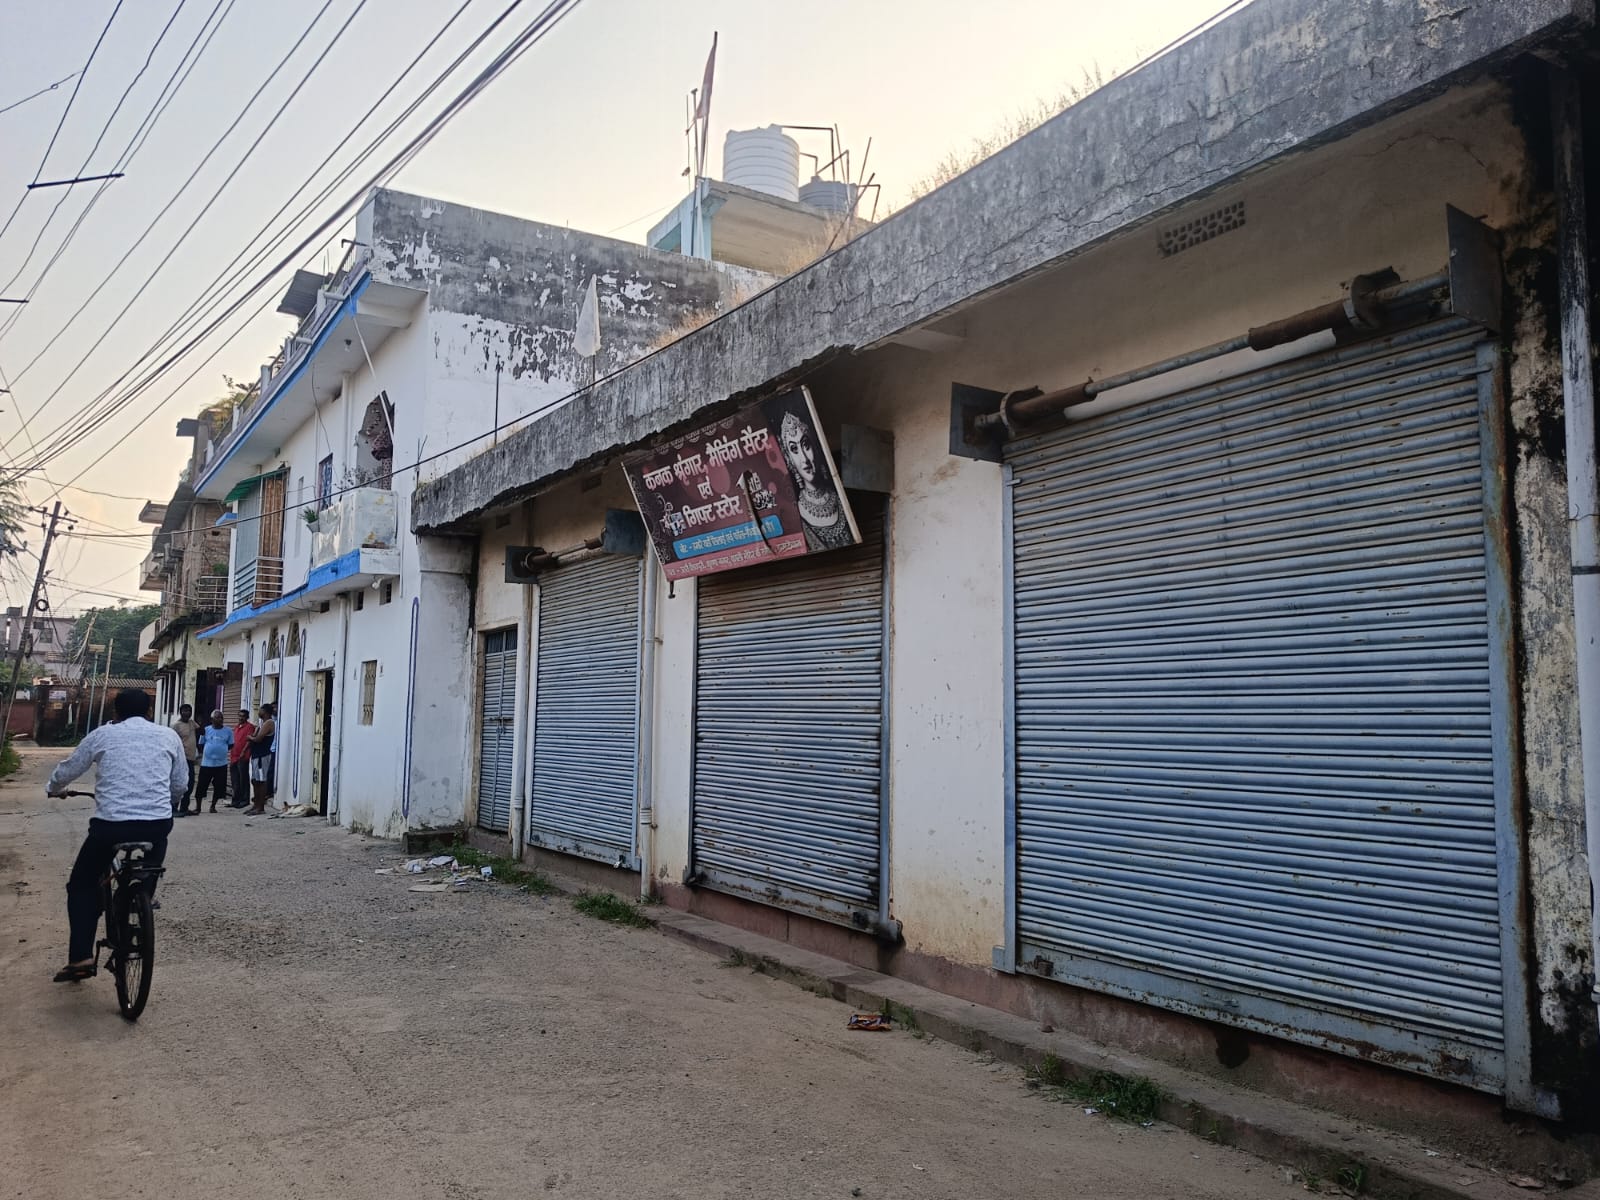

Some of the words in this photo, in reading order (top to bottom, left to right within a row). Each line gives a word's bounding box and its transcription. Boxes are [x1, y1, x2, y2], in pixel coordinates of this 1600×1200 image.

[643, 466, 674, 490] कनक
[705, 435, 743, 467] मैचिंग
[740, 425, 773, 456] सेंटर
[697, 475, 714, 499] एवं
[682, 504, 716, 527] गिफ्ट
[713, 493, 743, 519] स्टोर
